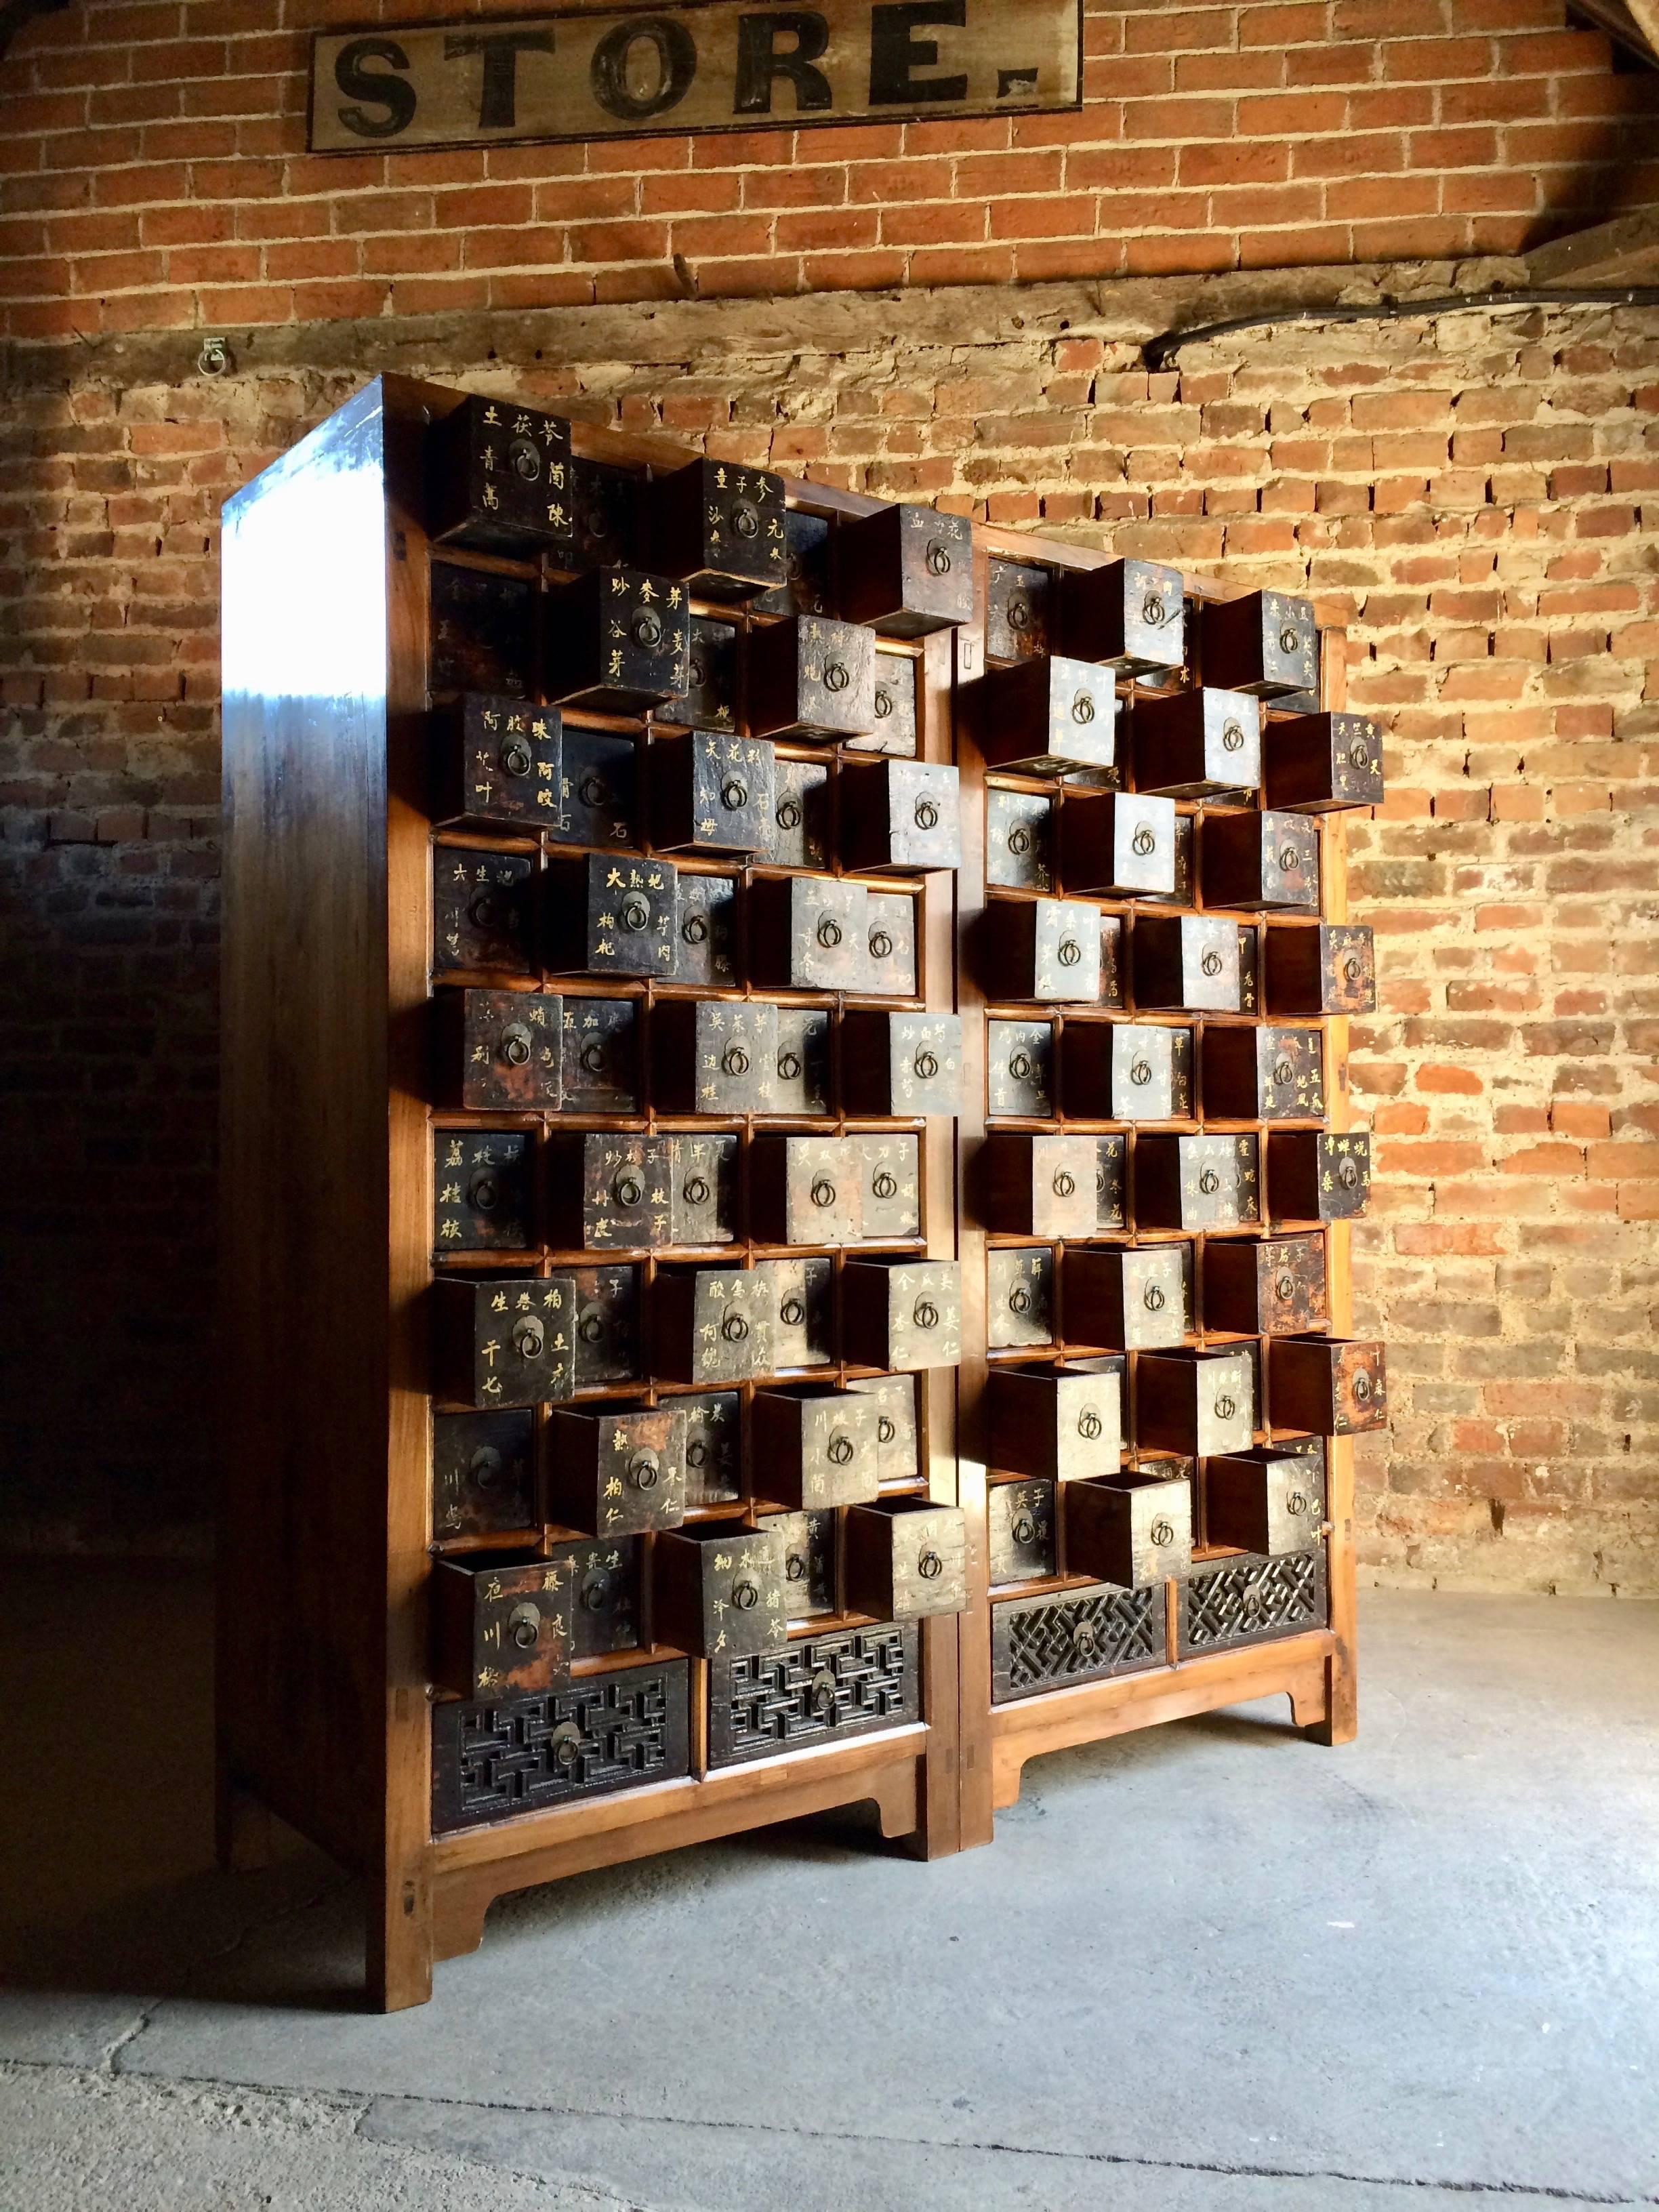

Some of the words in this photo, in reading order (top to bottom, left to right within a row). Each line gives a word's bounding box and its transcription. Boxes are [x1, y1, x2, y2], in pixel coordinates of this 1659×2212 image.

[483, 406, 563, 446] 土茯苓
[609, 619, 628, 678] 谷芽
[607, 867, 665, 890] 大熟地
